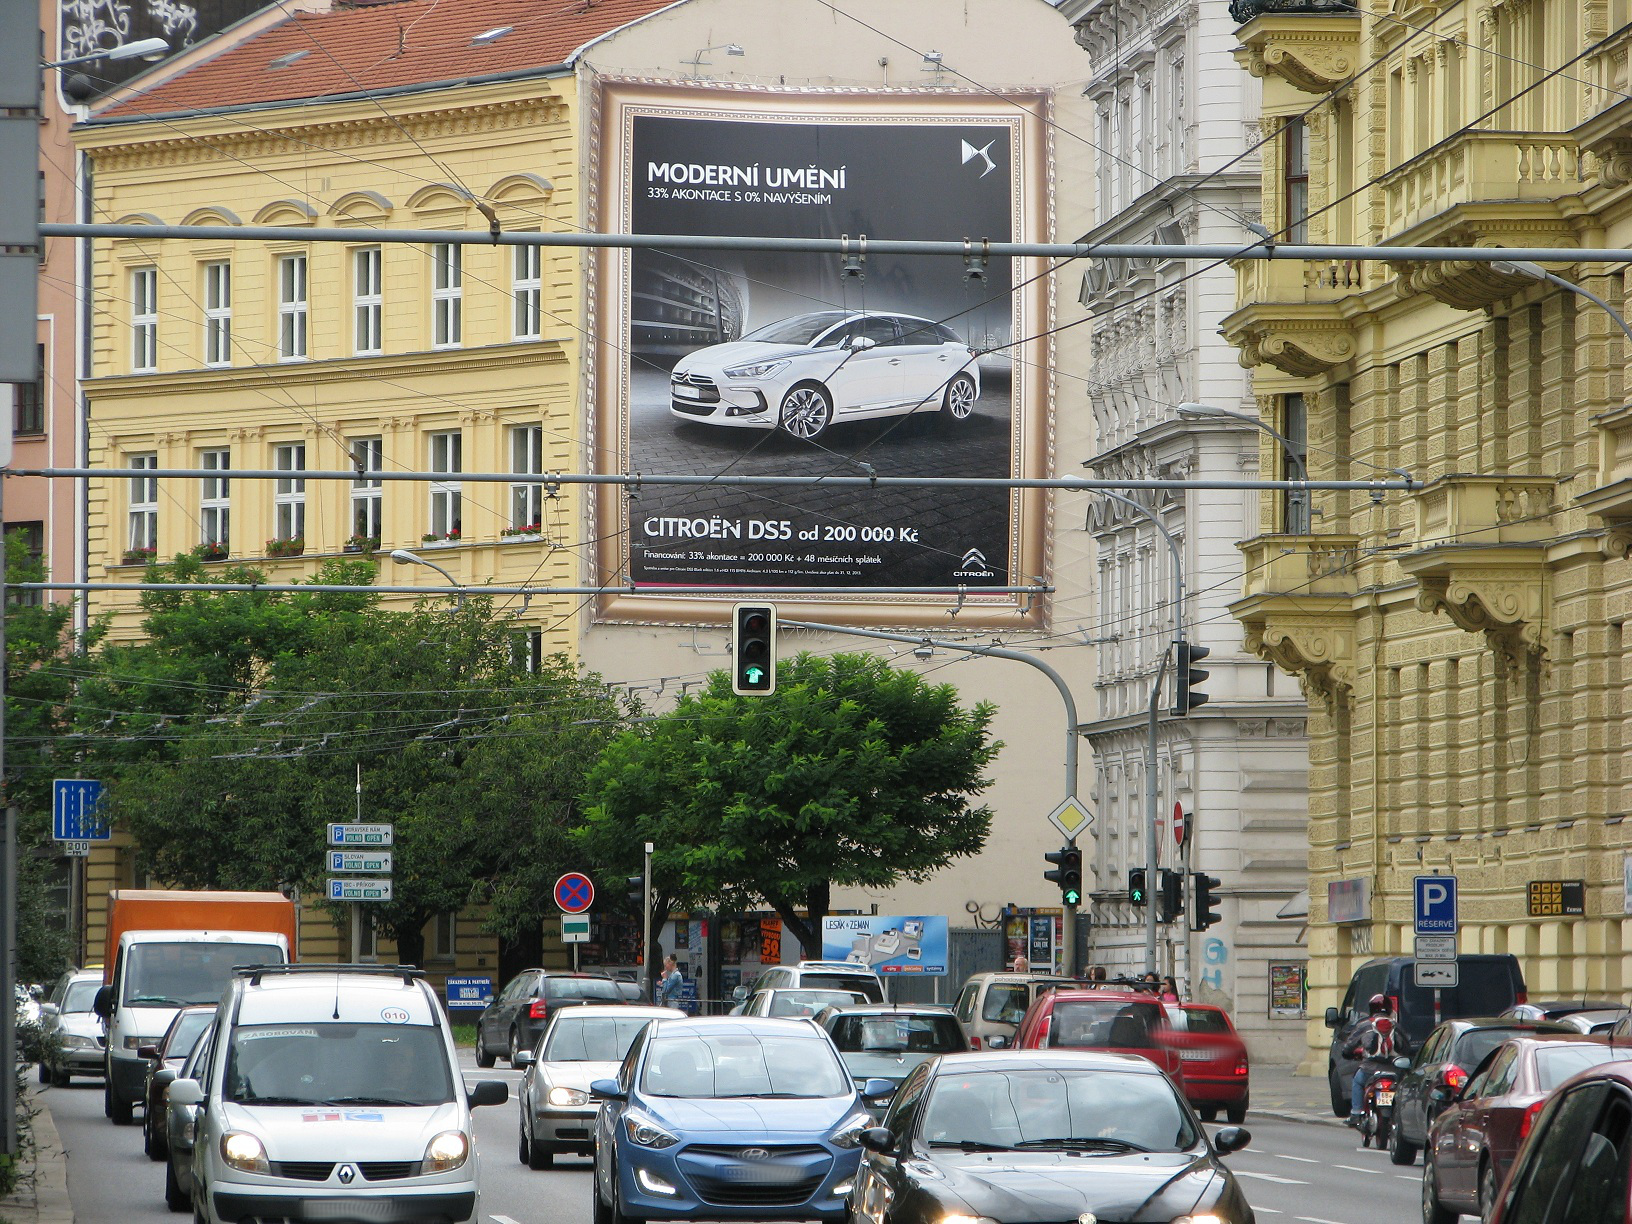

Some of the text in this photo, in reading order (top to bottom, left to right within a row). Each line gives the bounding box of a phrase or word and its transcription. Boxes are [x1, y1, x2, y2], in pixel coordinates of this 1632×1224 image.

[648, 161, 847, 189] MODERNÍ UMĚNÍ
[647, 187, 831, 205] 33% AKONTACE S 0% NAVÝŠENÍM
[644, 514, 919, 543] CITROËN DS5 od 200 000 Kč
[643, 549, 686, 560] Financování:
[688, 551, 705, 561] 33%
[706, 552, 738, 561] akontace
[747, 553, 764, 562] 200
[765, 554, 783, 563] 000
[784, 554, 795, 563] Kč
[803, 554, 816, 563] 48
[817, 555, 854, 564] měsíčních
[855, 555, 882, 566] splátek
[366, 834, 381, 842] OPEN
[67, 842, 88, 851] 200
[344, 890, 380, 898] VOLNO OPEN
[849, 920, 870, 930] ZEMAN
[1418, 919, 1453, 928] RÉSERVÉ
[384, 1012, 407, 1020] 010
